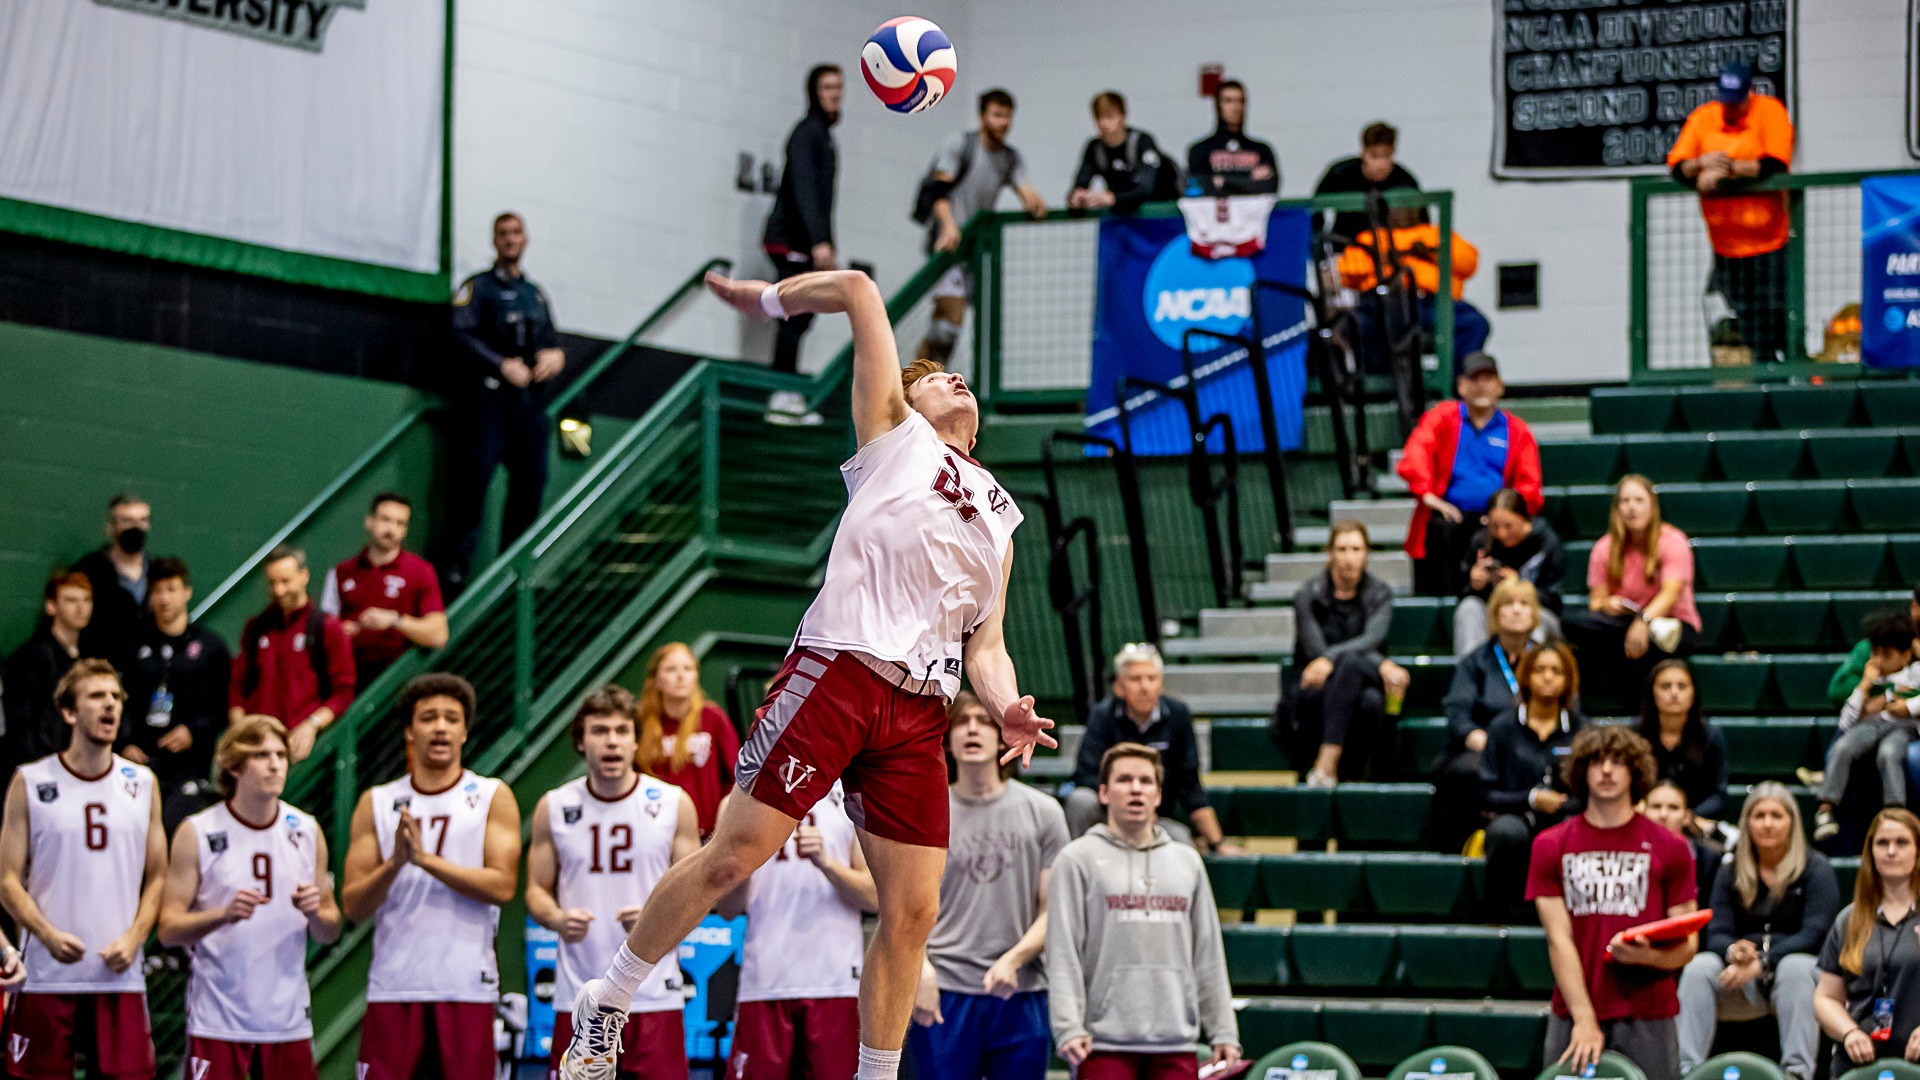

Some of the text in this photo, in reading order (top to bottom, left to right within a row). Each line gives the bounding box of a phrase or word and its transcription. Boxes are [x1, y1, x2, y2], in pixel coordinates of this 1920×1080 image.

[1505, 12, 1593, 52] NCAA
[1597, 3, 1745, 47] DIVISION
[1513, 86, 1649, 130] SECOND
[1155, 286, 1251, 322] NCAA
[84, 802, 108, 851] 6
[589, 823, 632, 873] 12
[252, 852, 273, 900] 9
